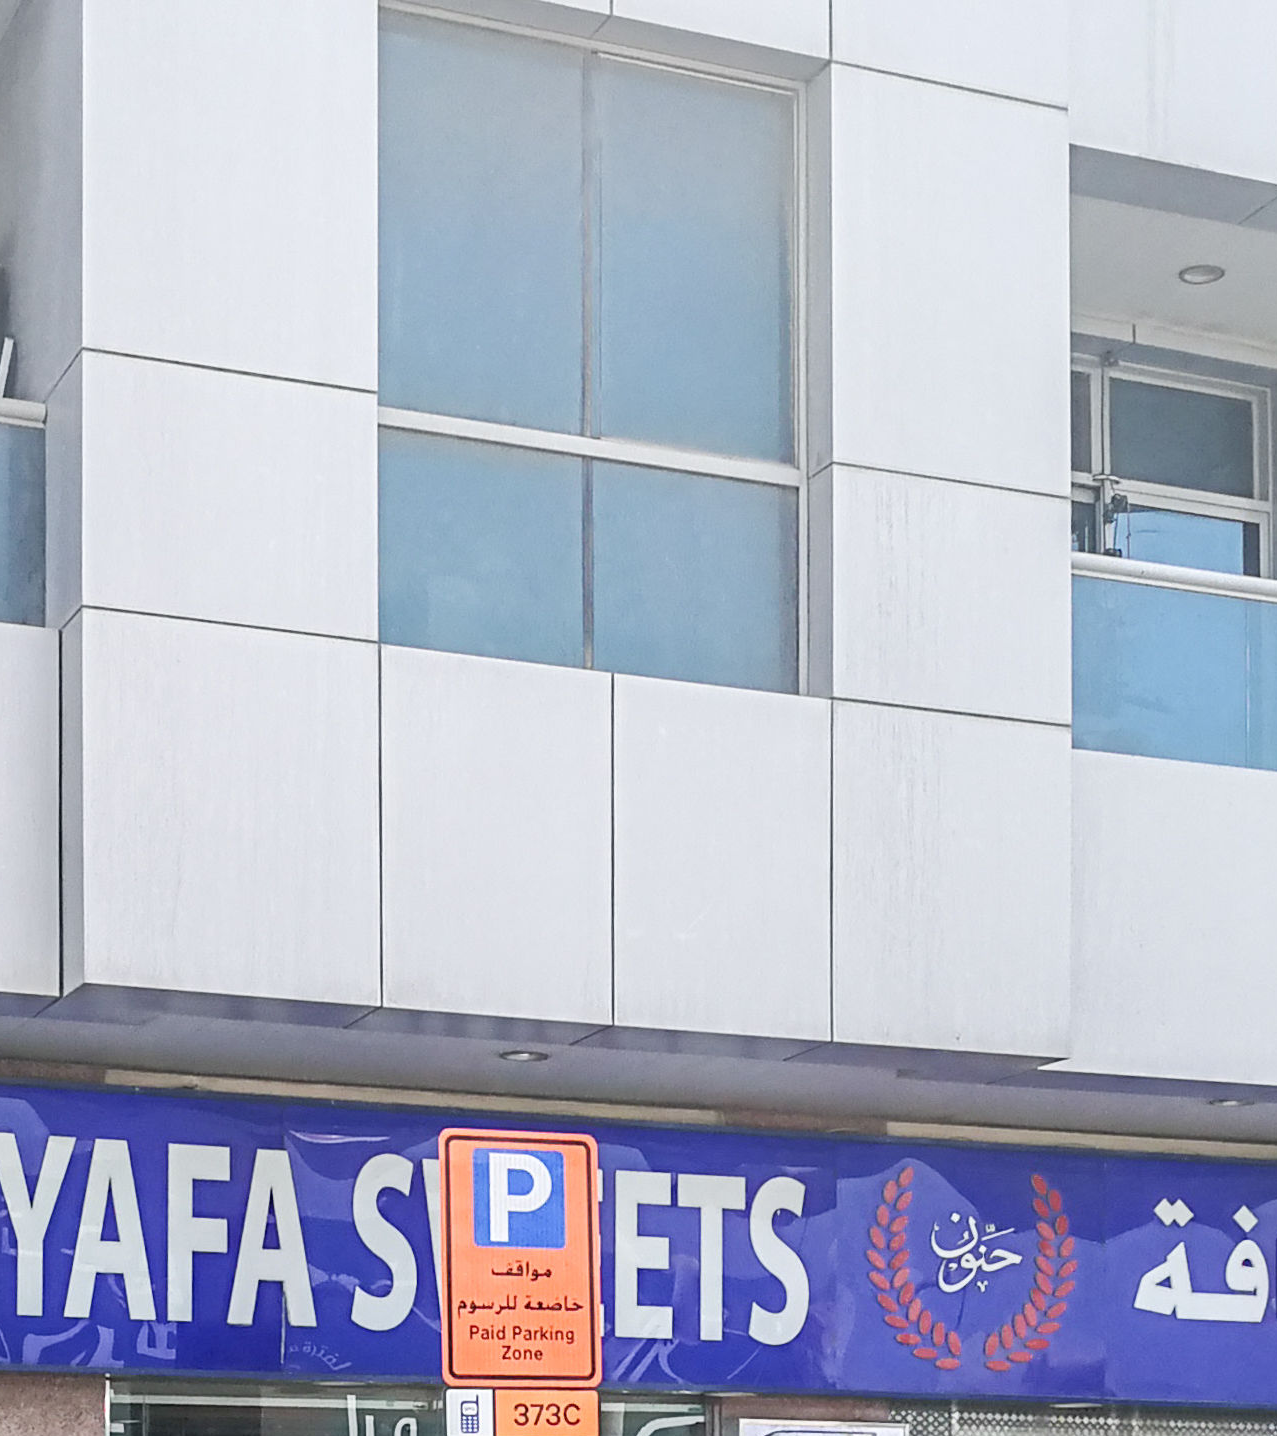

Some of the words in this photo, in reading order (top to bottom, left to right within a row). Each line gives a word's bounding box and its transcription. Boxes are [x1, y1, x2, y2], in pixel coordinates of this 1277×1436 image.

[488, 1152, 553, 1243] P
[350, 1153, 810, 1347] SETS
[490, 1259, 553, 1282] مواقف
[456, 1293, 518, 1319] للرسوم
[523, 1294, 585, 1313] خاضعة
[468, 1324, 506, 1341] Paid
[511, 1325, 576, 1345] Parking
[501, 1345, 544, 1361] Zone
[513, 1402, 581, 1427] 373C
